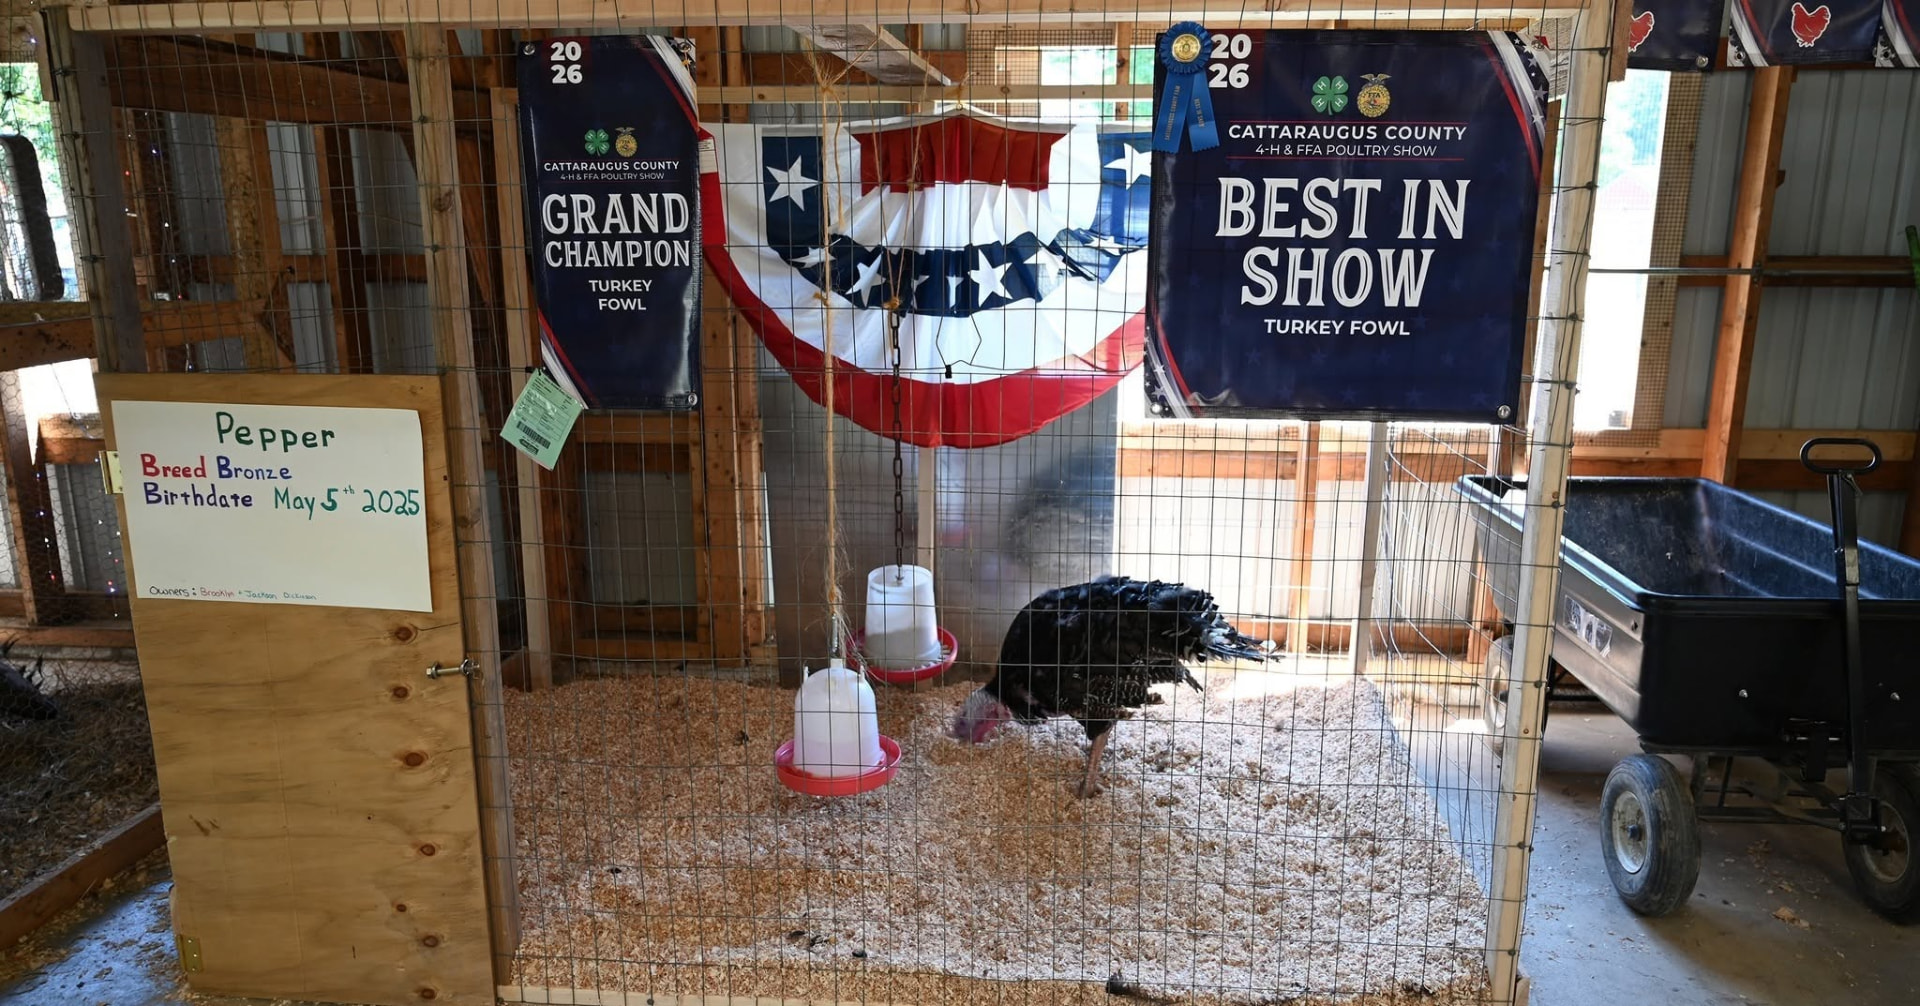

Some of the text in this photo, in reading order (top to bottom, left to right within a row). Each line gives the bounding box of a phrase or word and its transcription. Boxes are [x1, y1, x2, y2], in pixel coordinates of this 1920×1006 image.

[550, 41, 582, 61] 20
[1210, 33, 1252, 60] 20
[551, 64, 583, 84] 26
[1208, 62, 1250, 88] 26
[1228, 124, 1467, 141] CATTARAUGUS COUNTY
[1255, 143, 1437, 157] 4-H & FFA POULTRY SHOW
[544, 160, 680, 172] CATTARAUGUS COUNTY
[560, 172, 665, 181] 4-H & FFA POULTRY SHOW
[542, 193, 689, 235] GRAND
[1215, 177, 1471, 240] BEST IN
[545, 240, 690, 268] CHAMPION
[588, 279, 653, 293] TURKEY
[1240, 246, 1435, 308] SHOW
[598, 298, 647, 311] FOWL
[1263, 318, 1411, 336] TURKEY FOWL
[215, 411, 336, 453] Pepper
[139, 453, 293, 481] Breed Bronze
[143, 481, 253, 508] Birthdate
[274, 486, 316, 521] May
[361, 489, 420, 516] 2025
